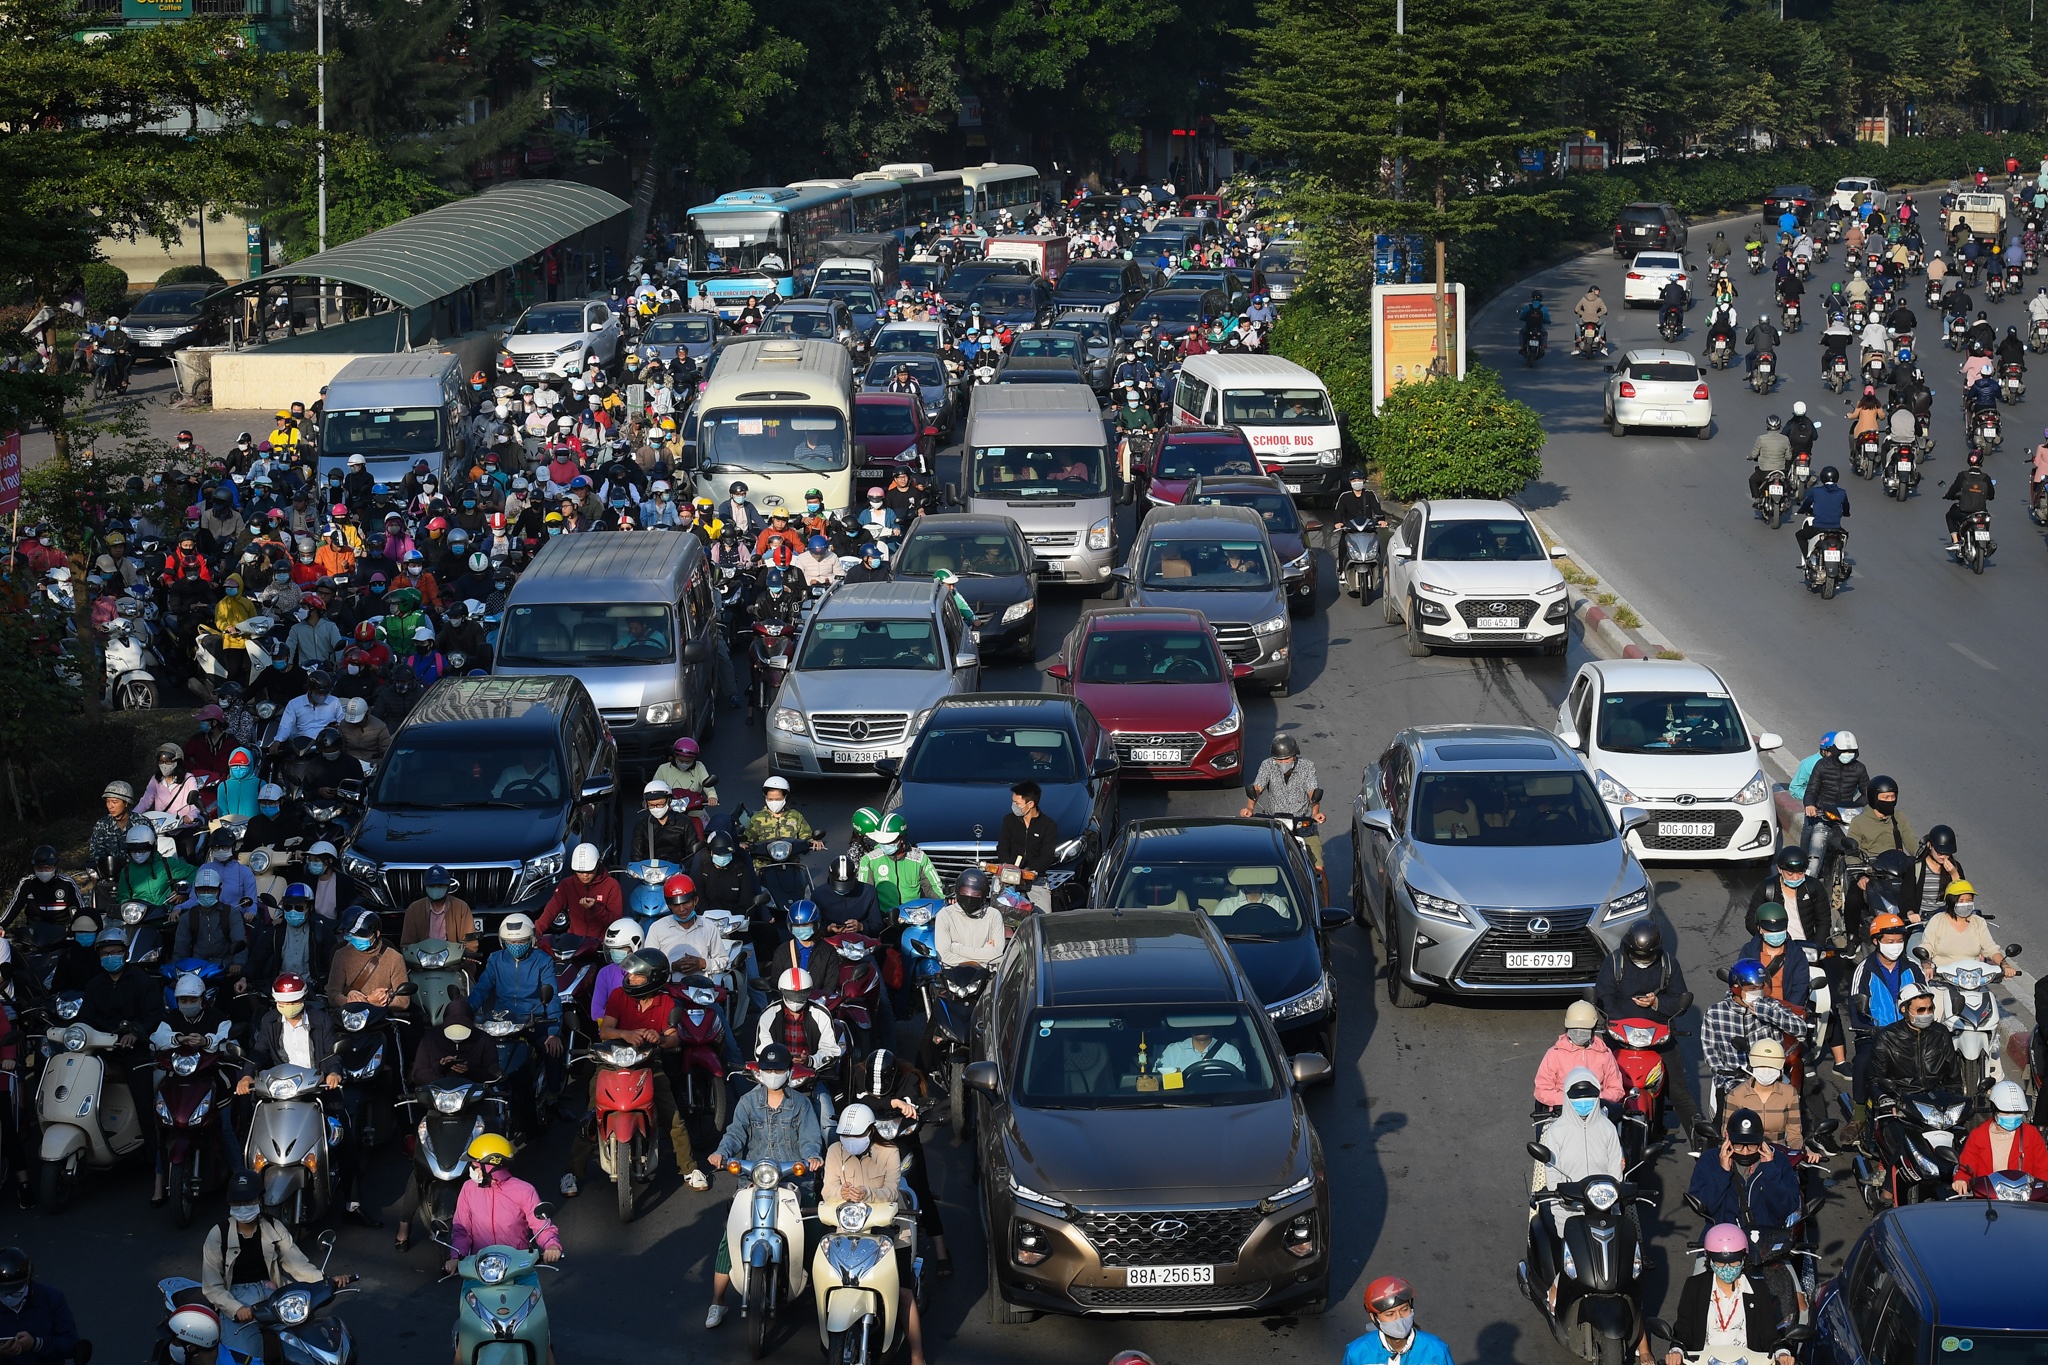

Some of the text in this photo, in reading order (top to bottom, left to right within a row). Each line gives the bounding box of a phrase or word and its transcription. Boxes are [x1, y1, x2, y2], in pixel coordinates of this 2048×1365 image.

[1253, 435, 1314, 446] SCHOOL BUS
[2, 452, 18, 469] GÓP
[1478, 617, 1519, 626] 30G-452.19
[835, 750, 885, 762] 30A-238.65
[1131, 748, 1181, 760] 30G-156.73
[1660, 822, 1713, 834] 30G-001.82
[1508, 953, 1572, 966] 30E-679.79
[1129, 1266, 1212, 1283] 88A-256.53
